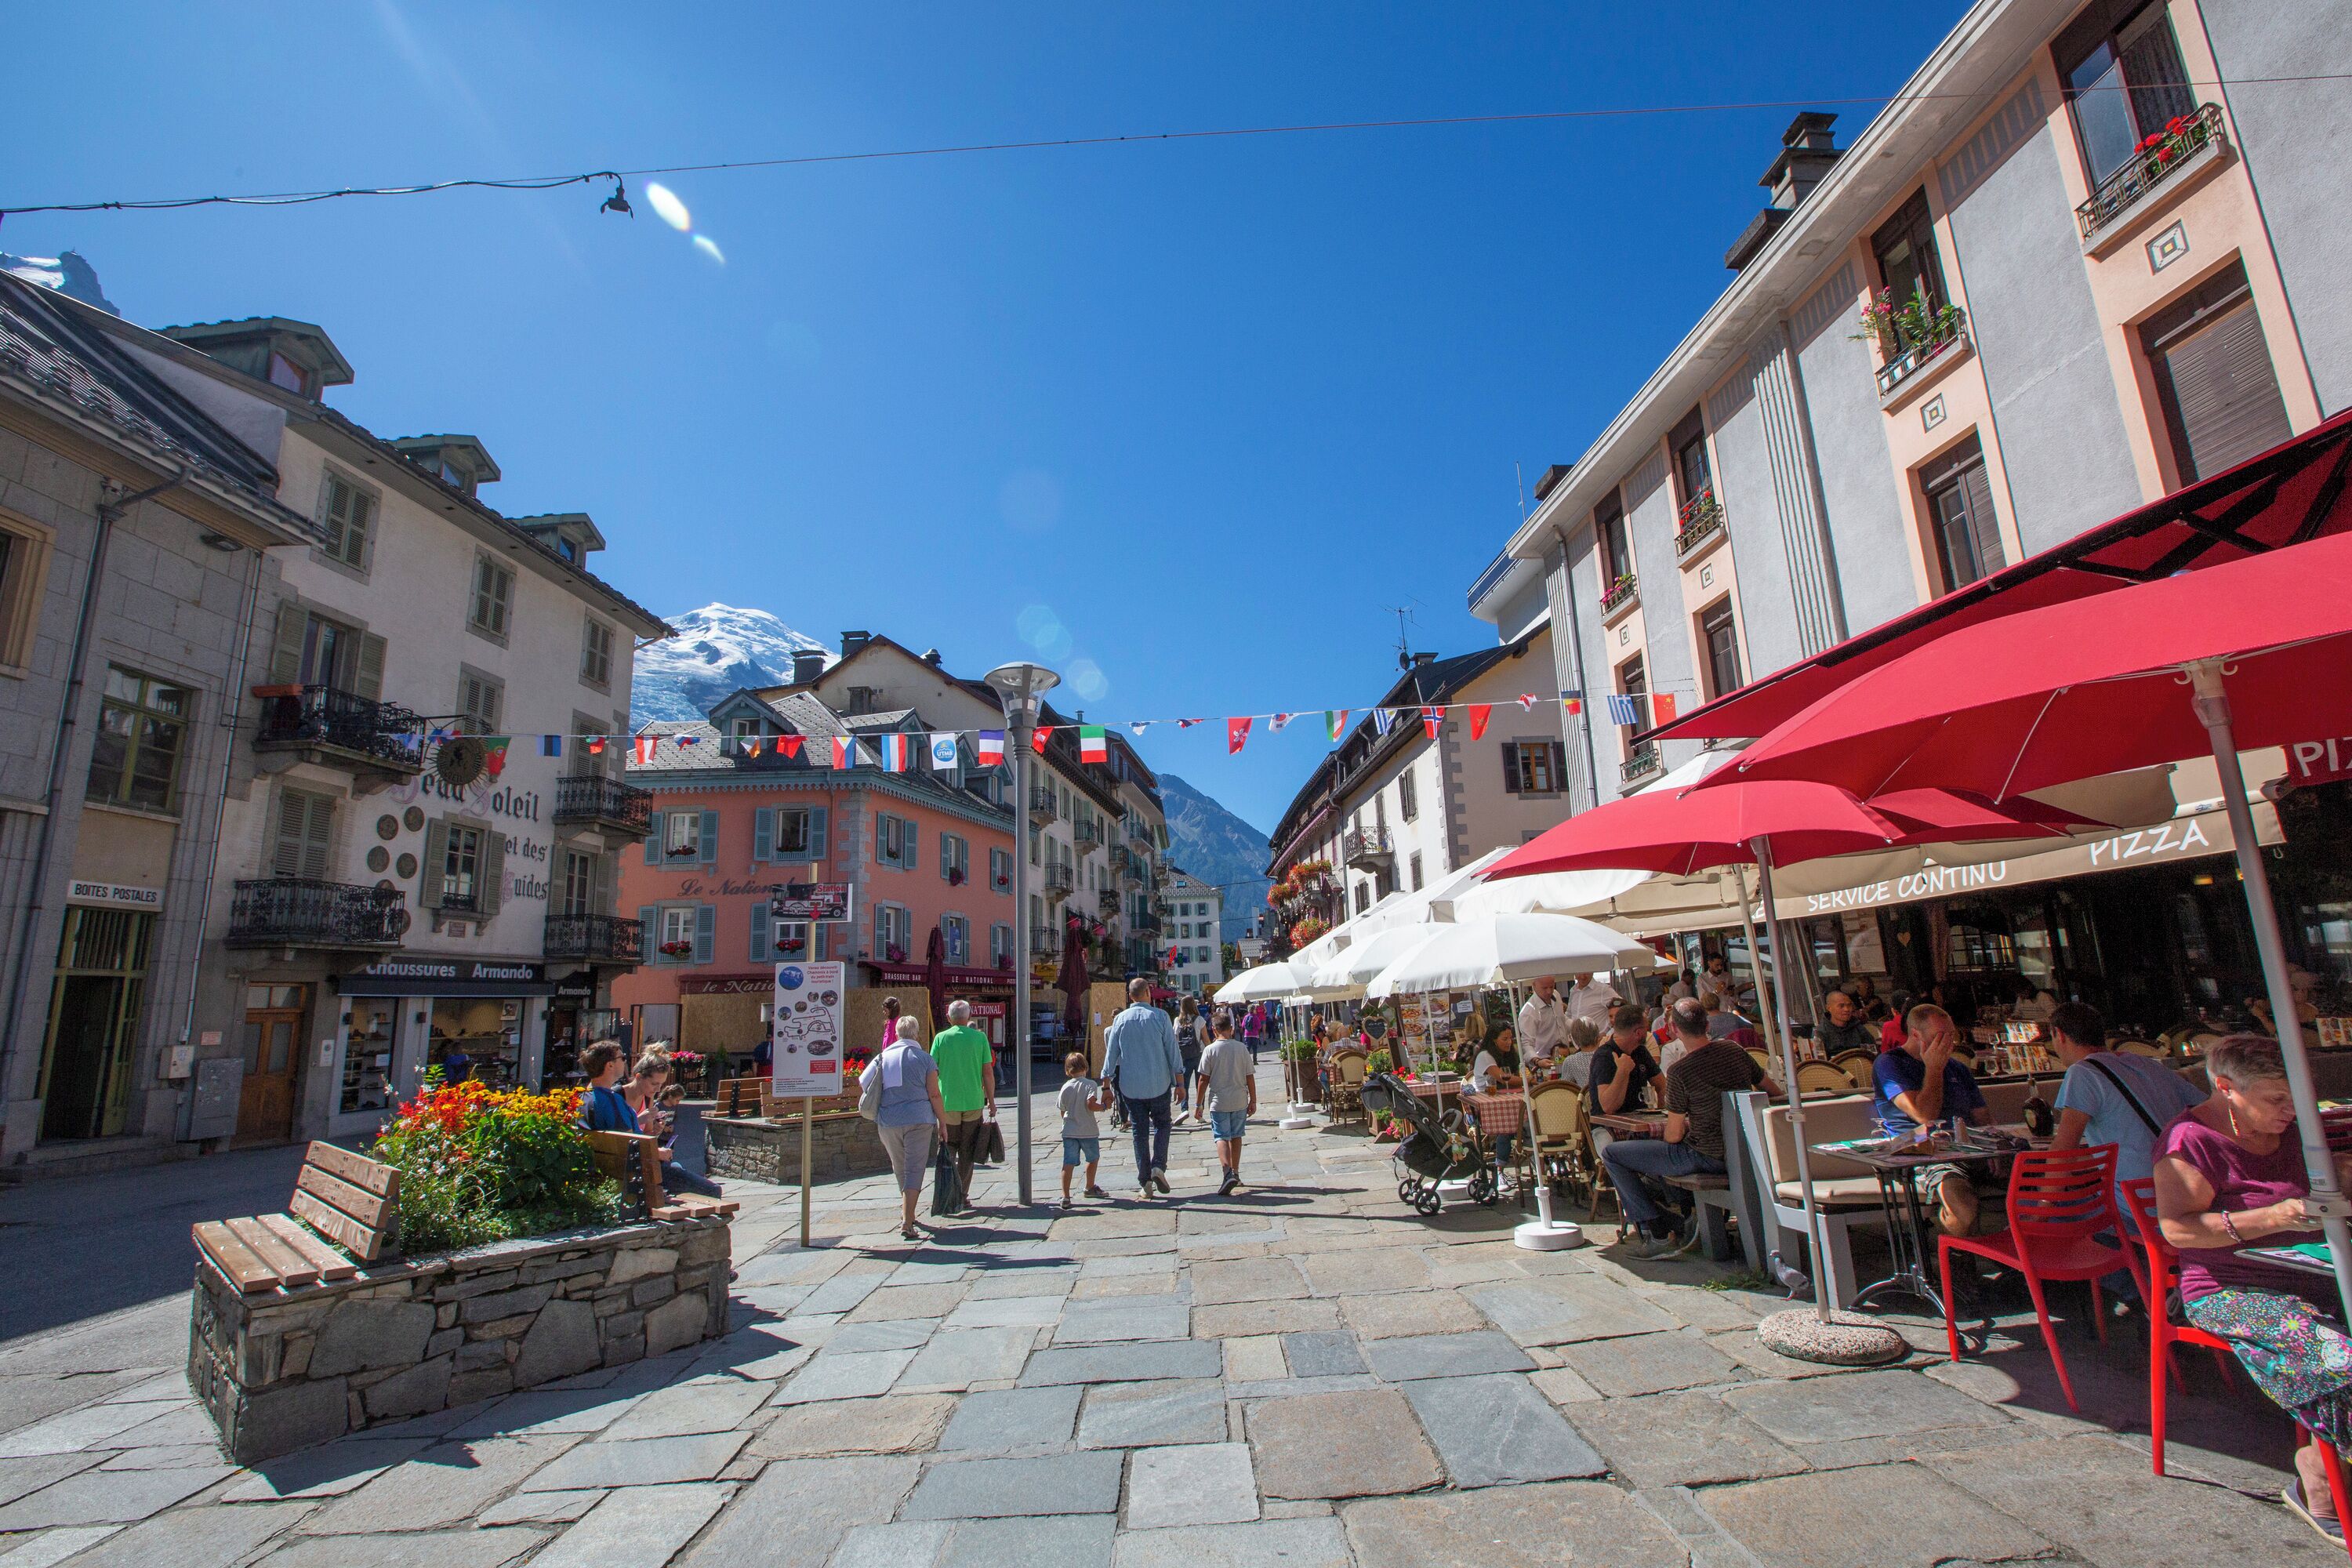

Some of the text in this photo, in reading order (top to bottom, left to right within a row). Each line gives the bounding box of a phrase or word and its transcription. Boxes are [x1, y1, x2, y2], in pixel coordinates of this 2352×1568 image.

[523, 837, 548, 862] des
[2089, 819, 2209, 866] PIZZA
[74, 884, 158, 902] BOITES POSTALES
[677, 877, 795, 897] Le Nation
[817, 884, 846, 893] Station
[1807, 880, 1891, 912] SERVICE
[1897, 860, 2008, 898] CONTINU
[471, 963, 533, 980] Armando
[557, 985, 591, 996] Armando
[702, 980, 775, 993] le Natio
[970, 1005, 1002, 1014] NATIONAL
